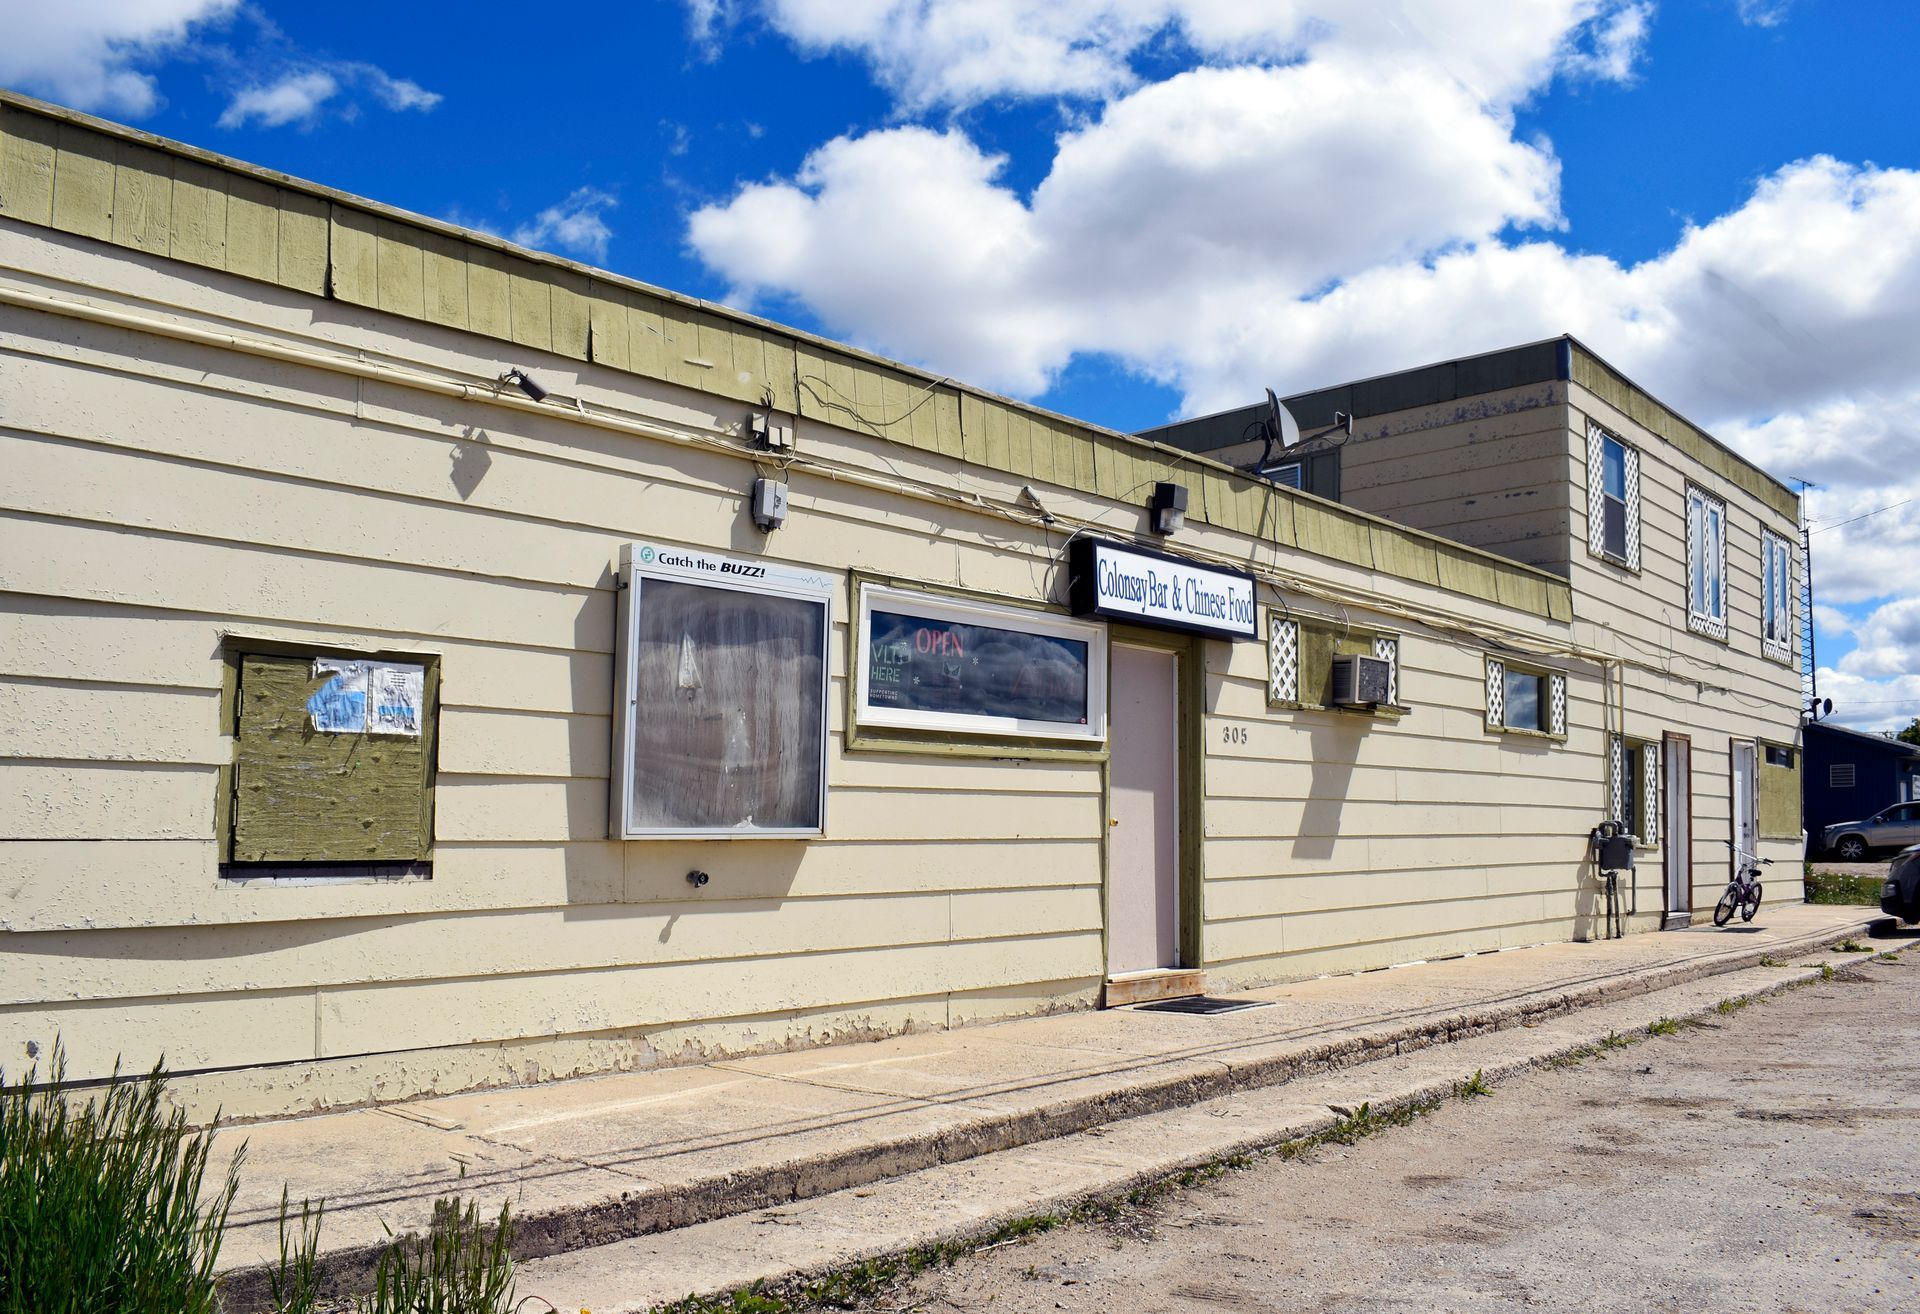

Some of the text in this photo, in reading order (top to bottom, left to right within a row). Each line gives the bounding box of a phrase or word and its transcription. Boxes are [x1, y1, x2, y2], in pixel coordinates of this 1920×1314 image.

[658, 552, 766, 578] Catch the BUZZ!
[1098, 558, 1253, 625] Colonsay Bar & Chinese Food
[915, 627, 965, 658] OPEN
[870, 665, 901, 682] HERE
[1222, 726, 1248, 744] 305
